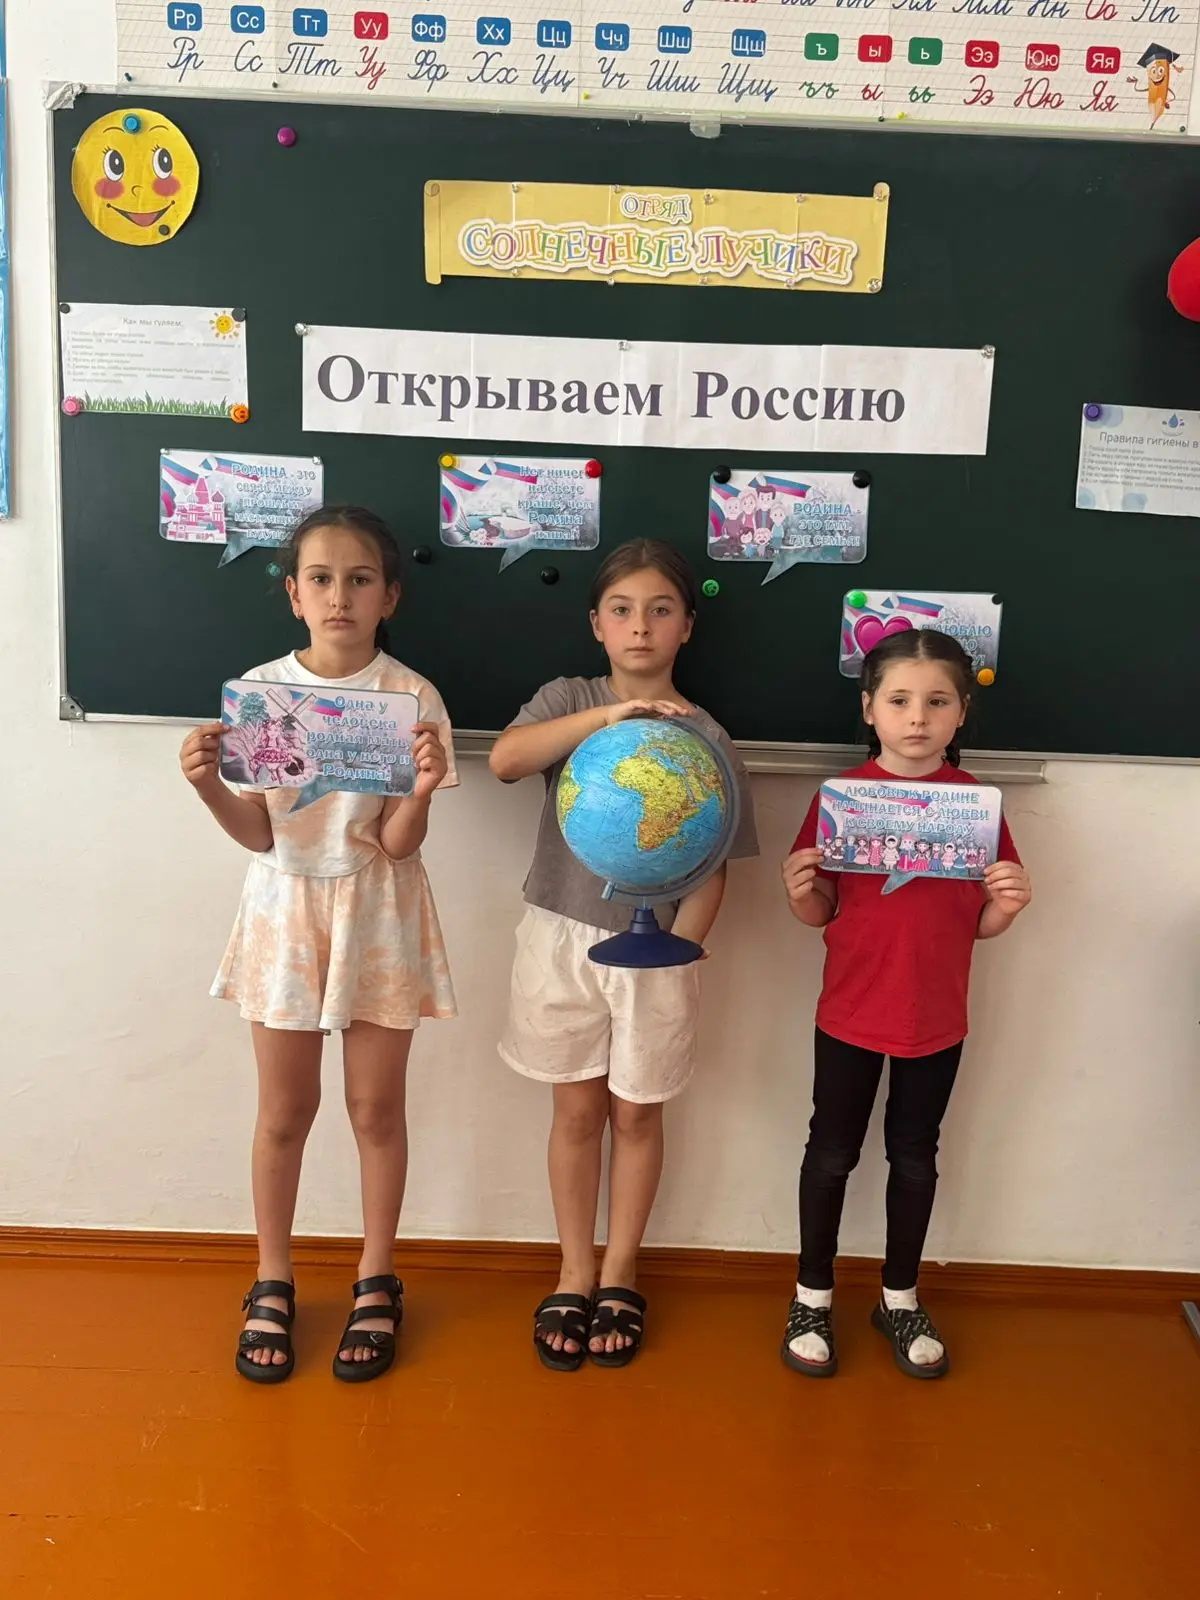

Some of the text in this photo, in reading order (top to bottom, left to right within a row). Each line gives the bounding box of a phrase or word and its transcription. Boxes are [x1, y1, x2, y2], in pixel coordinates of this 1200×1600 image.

[173, 9, 197, 28] Рр
[236, 12, 260, 30] Сс
[300, 15, 321, 33] Тт
[360, 17, 382, 37] Уу
[413, 20, 444, 42] Фф
[482, 23, 505, 41] Хх
[542, 26, 567, 47] Цц
[601, 29, 624, 46] Чч
[659, 31, 691, 49] Шш
[732, 35, 765, 56] Щщ
[868, 45, 882, 58] ы
[970, 46, 994, 63] Ээ
[1027, 50, 1059, 67] Юю
[1091, 53, 1115, 70] Яя
[167, 37, 204, 83] Рр
[234, 40, 263, 73] Сс
[279, 42, 342, 77] Тт
[355, 46, 387, 90] Уу
[407, 50, 449, 92] Фф
[467, 51, 519, 85] Хх
[531, 53, 576, 94] Цц
[598, 57, 630, 89] Чч
[646, 59, 702, 92] Шш
[716, 62, 778, 103] Щщ
[963, 74, 995, 106] Ээ
[1013, 78, 1065, 110] Юю
[1079, 80, 1120, 112] Яя
[623, 192, 690, 220] ОТРЯД
[464, 225, 855, 276] СОЛНЕЧНЫЕ ЛУЧИКИ
[316, 353, 907, 424] Открываем Россию
[1099, 431, 1145, 446] Правила
[1146, 436, 1190, 449] гигиены
[793, 502, 853, 517] РОДИНА
[334, 696, 388, 714] Одна у
[322, 715, 398, 730] человека
[307, 731, 364, 744] родная
[306, 748, 345, 761] одна
[347, 751, 358, 763] у
[844, 785, 906, 801] ЛЮБОВЬ
[920, 789, 980, 804] РОДИНЕ
[832, 800, 921, 817] НАЧИНАЕТСЯ
[937, 807, 990, 821] ЛЮБВИ
[855, 819, 914, 833] СВОЕМУ
